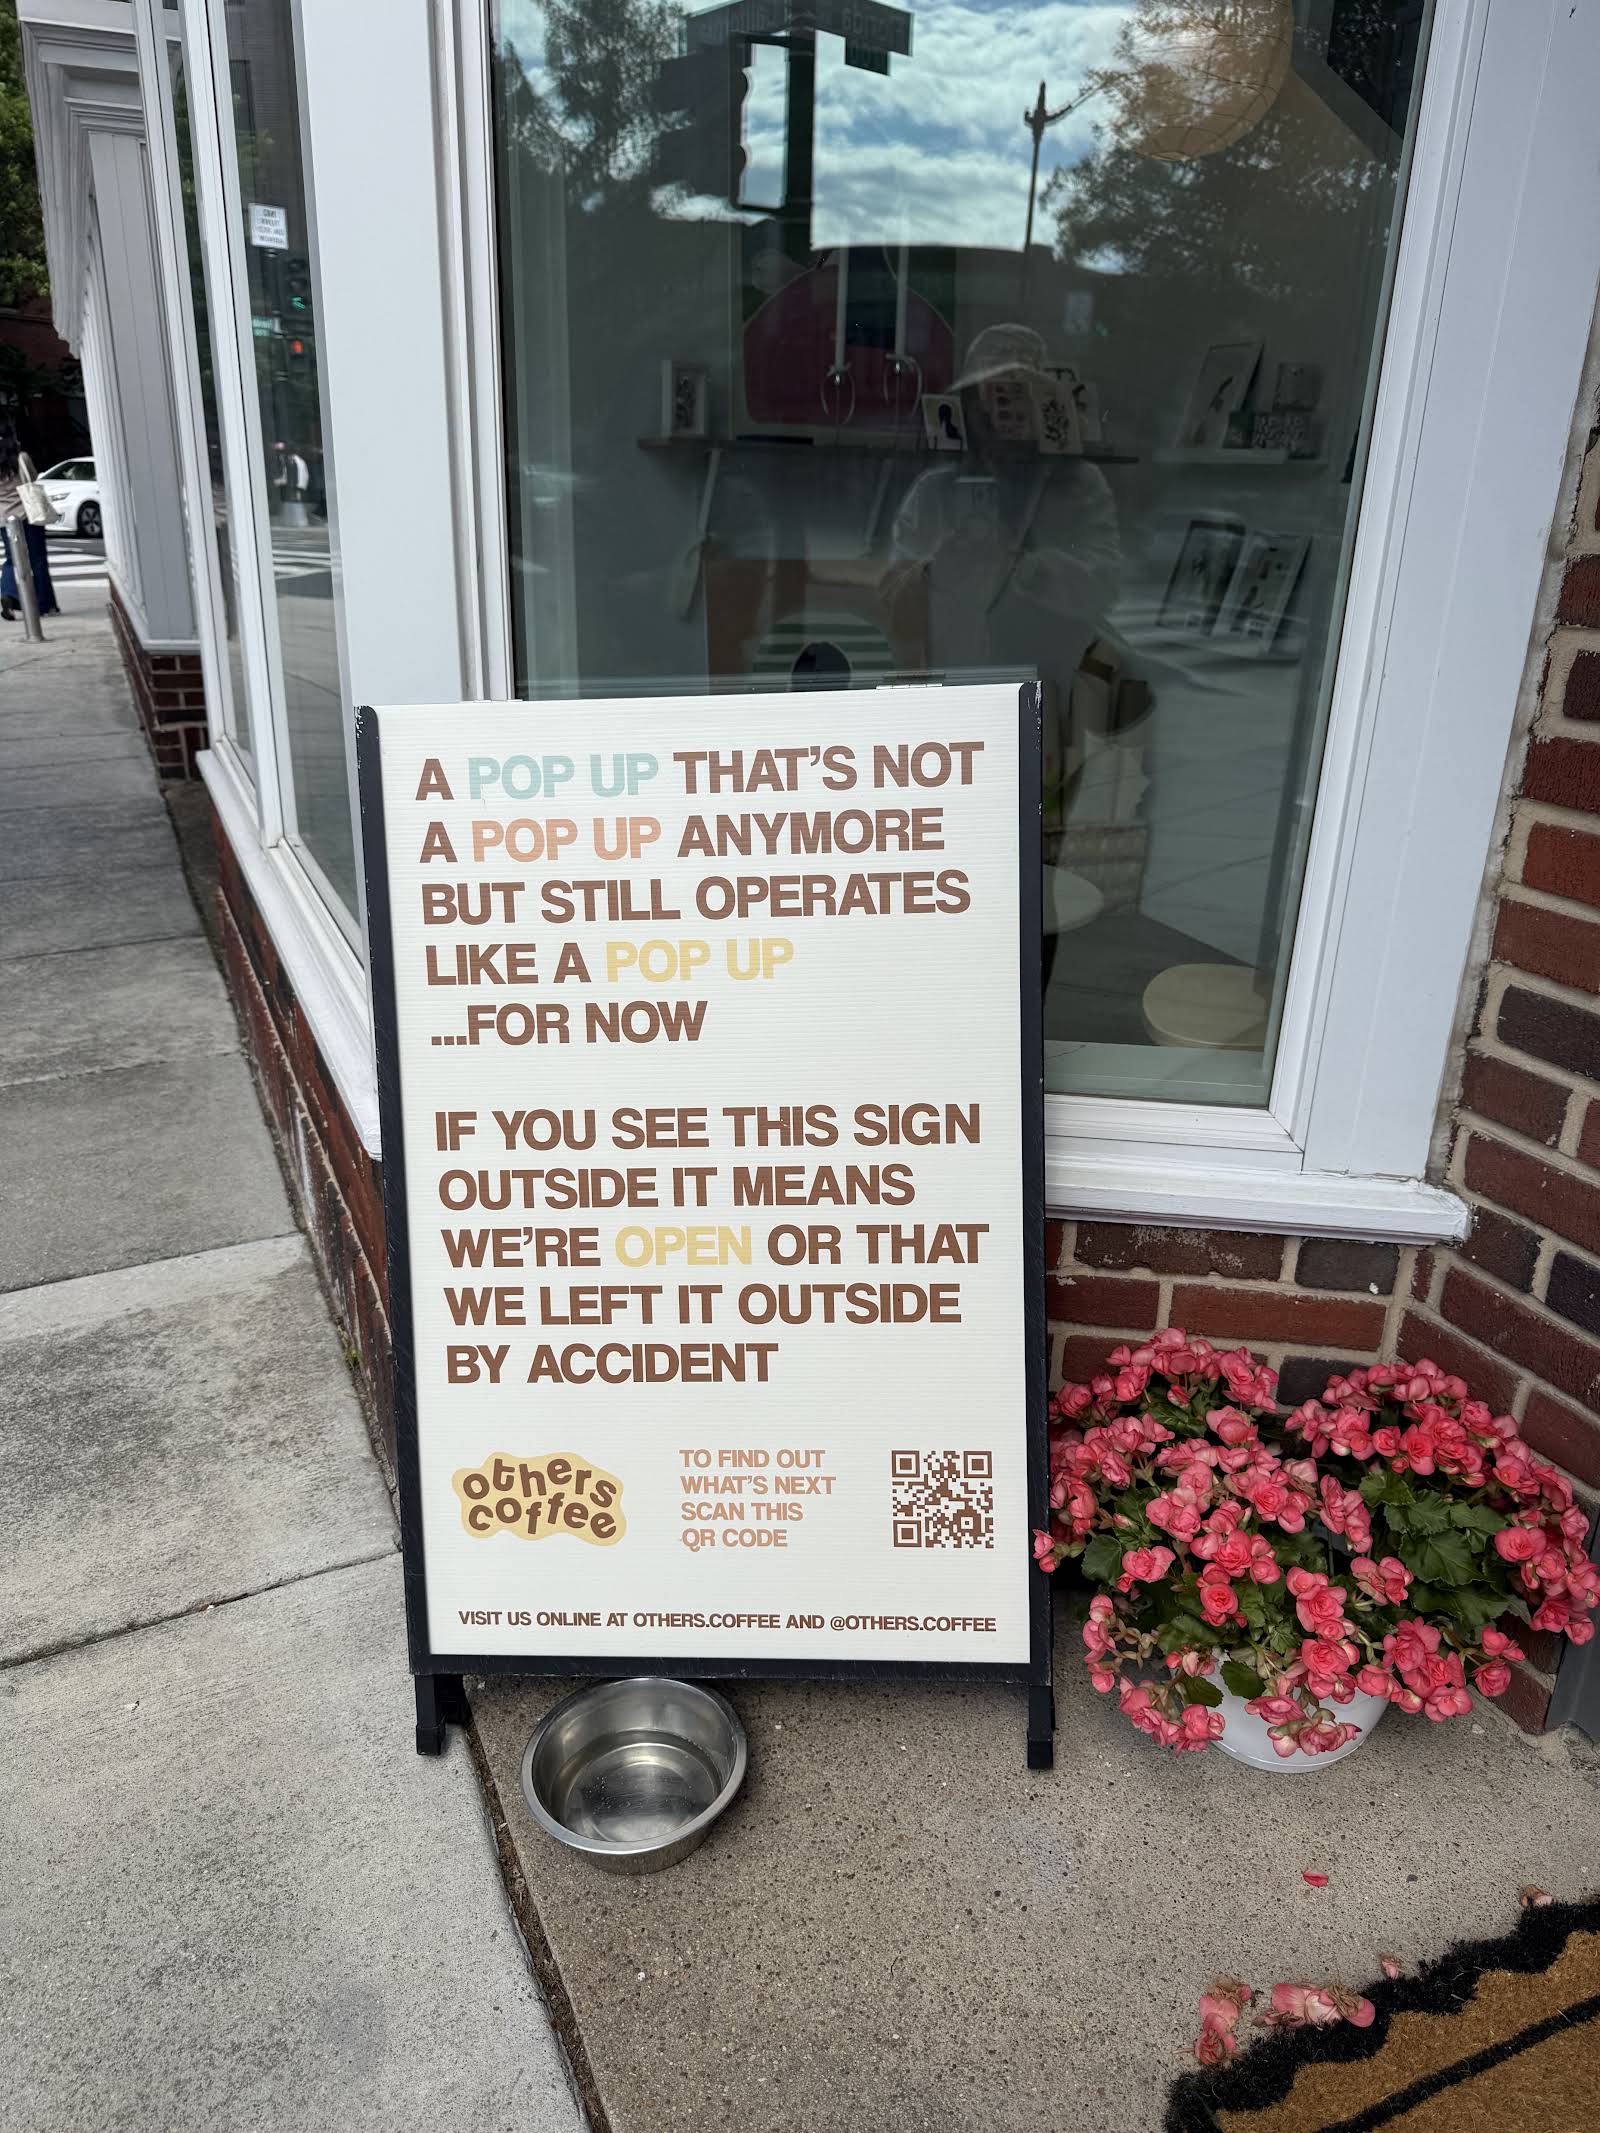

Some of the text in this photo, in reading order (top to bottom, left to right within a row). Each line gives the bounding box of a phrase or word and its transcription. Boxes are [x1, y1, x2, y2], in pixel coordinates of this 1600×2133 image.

[415, 741, 985, 801] A POP UP THAT’S NOT
[420, 807, 945, 863] A POP UP ANYMORE
[421, 869, 971, 926] BUT STILL OPERATES
[425, 937, 794, 986] LIKE A POP UP
[584, 1000, 708, 1044] NOW
[435, 1103, 981, 1152] IF YOU SEE THIS SIGN
[438, 1163, 916, 1211] OUTSIDE IT MEANS
[441, 1223, 990, 1269] WE’RE OPEN OR THAT
[443, 1282, 962, 1327] WE LEFT IT OUTSIDE
[446, 1342, 779, 1385] BY ACCIDENT
[679, 1448, 825, 1470] TO FIND OUT
[462, 1457, 617, 1510] others
[680, 1475, 836, 1496] WHAT’S NEXT
[468, 1495, 617, 1539] coffee
[681, 1501, 804, 1522] SCAN THIS
[682, 1527, 786, 1553] QR CODE
[458, 1610, 997, 1633] VISIT US ONLINE AT OTHERS.COFFEE AND @OTHERS.COFFEE
